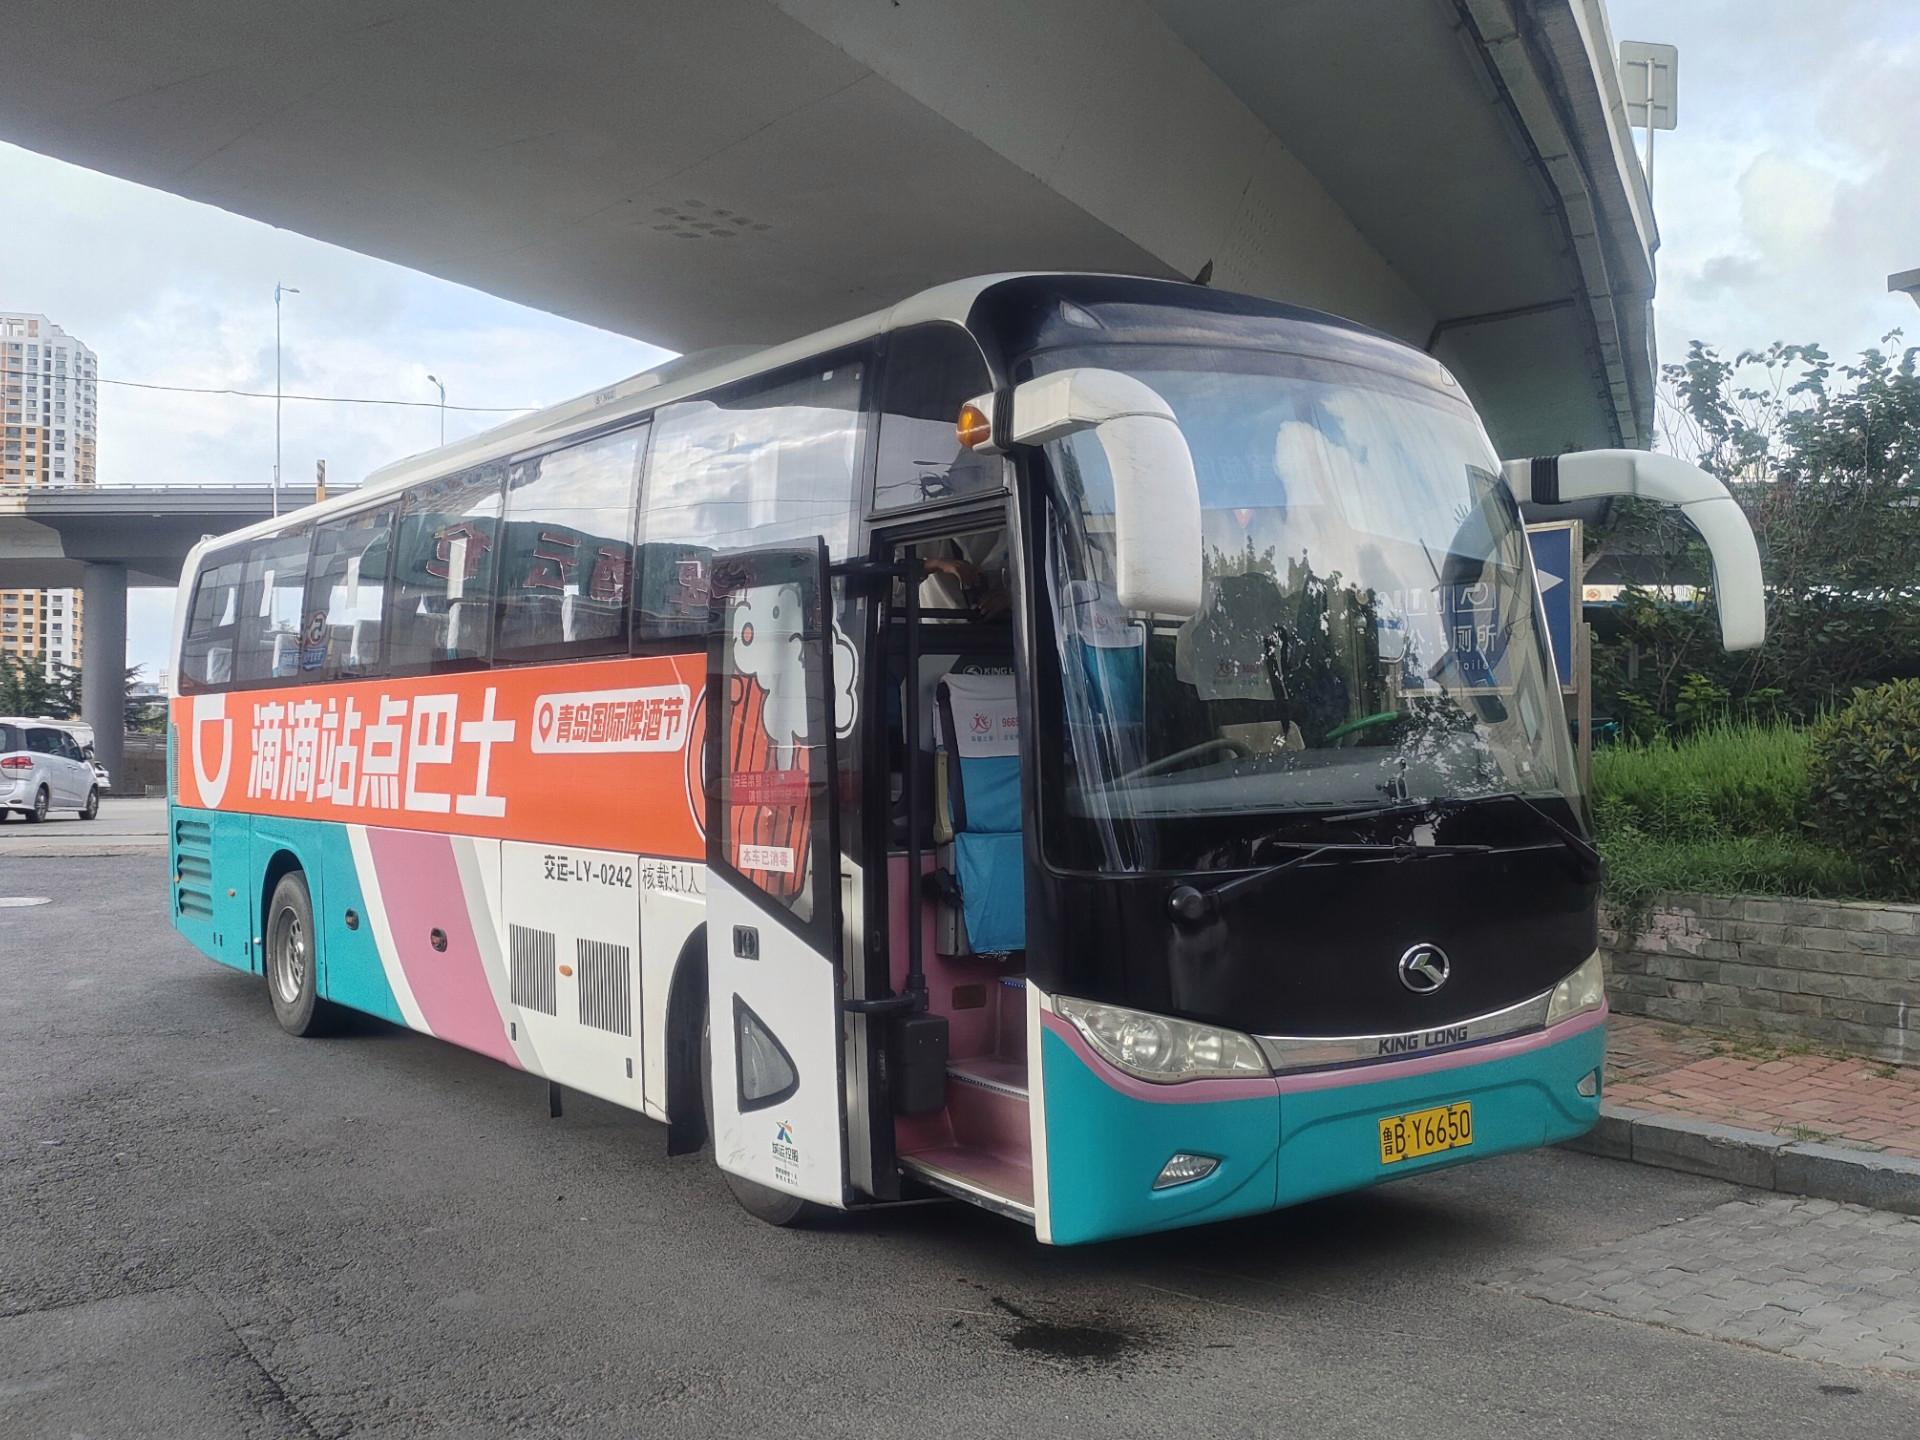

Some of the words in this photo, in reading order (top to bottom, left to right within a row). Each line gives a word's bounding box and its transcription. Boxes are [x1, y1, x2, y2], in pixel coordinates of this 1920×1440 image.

[557, 697, 684, 743] 青岛国际啤酒节
[247, 687, 515, 817] 滴滴站点巴士
[544, 854, 633, 888] 交运-LY-0242
[743, 848, 788, 867] 本车已消毒
[642, 862, 706, 894] 核载51人
[1379, 1035, 1418, 1054] KING
[1426, 1027, 1468, 1046] LONG
